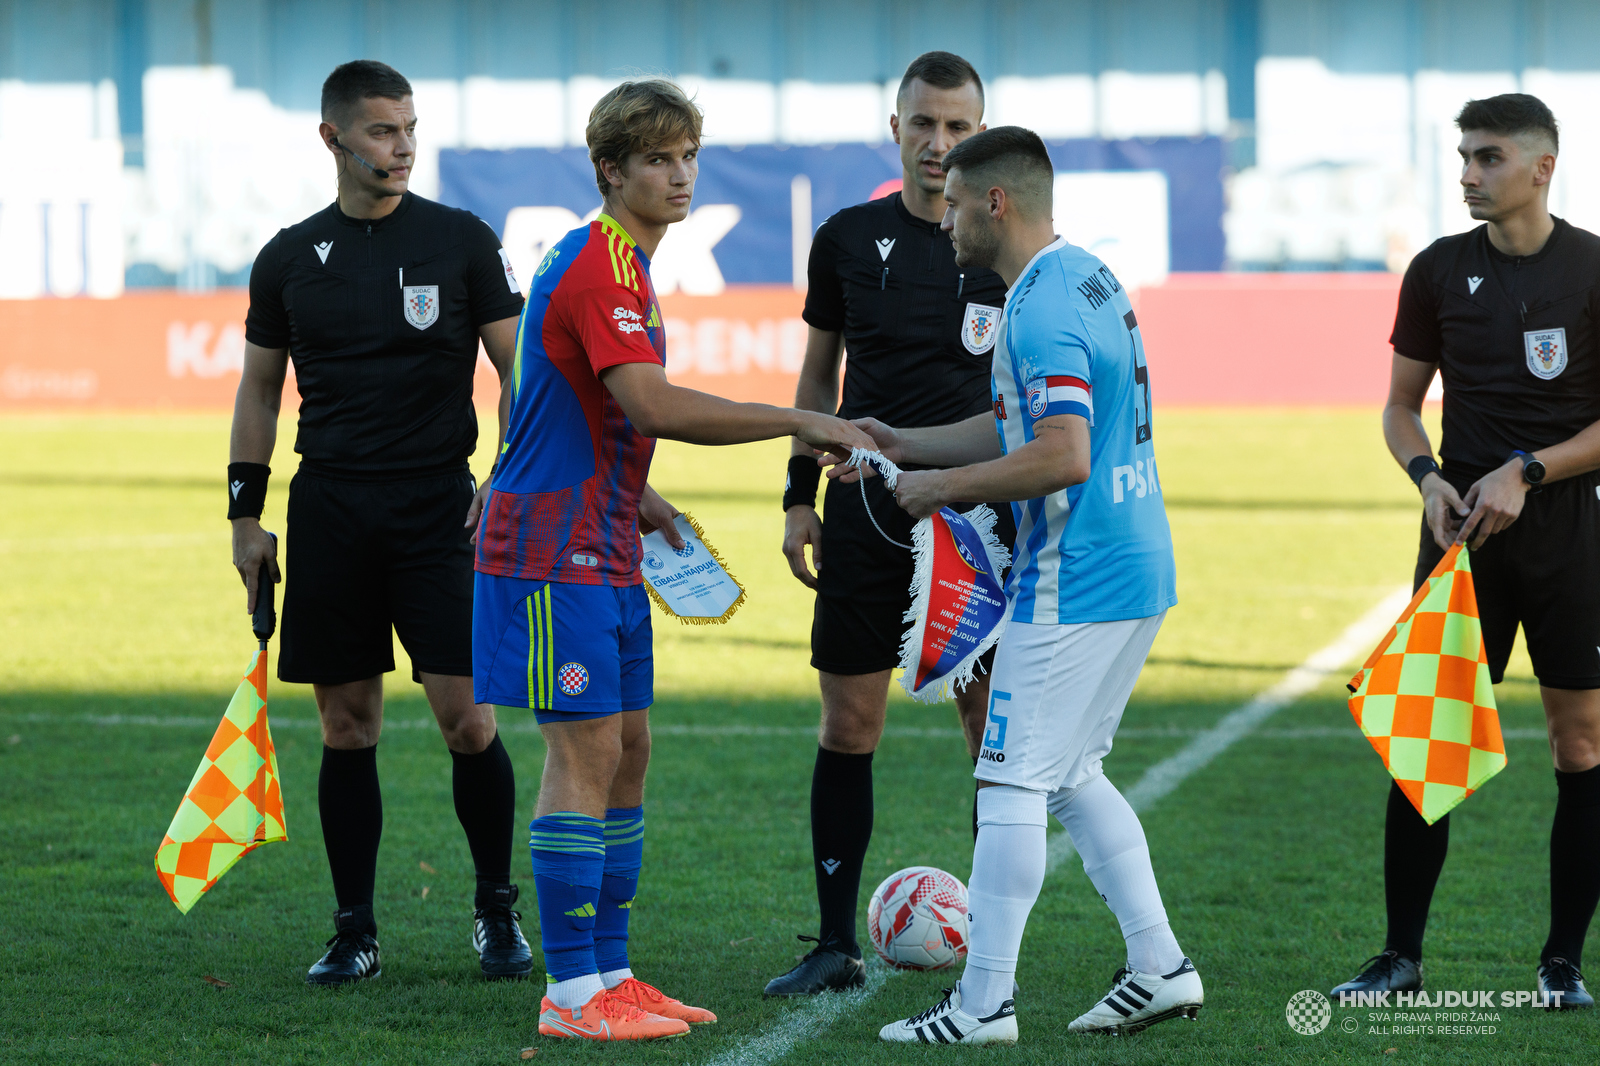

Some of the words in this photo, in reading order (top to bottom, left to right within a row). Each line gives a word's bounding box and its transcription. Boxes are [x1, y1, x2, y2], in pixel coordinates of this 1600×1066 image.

[1077, 273, 1112, 311] HNK
[707, 566, 720, 575] SPLIT
[938, 579, 963, 592] HRVATSKI
[963, 587, 992, 603] NOGOMETNI
[991, 599, 1001, 607] KUP
[957, 579, 988, 594] SUPERSPORT
[958, 594, 979, 606] 2025/26
[960, 605, 978, 616] FINALA
[940, 609, 955, 620] HNK
[955, 615, 980, 629] CIBALIA
[930, 620, 947, 632] HNK
[947, 627, 978, 644] HAJDUK
[937, 637, 960, 650] Vinkovci
[560, 664, 585, 674] HAJDUK
[562, 686, 582, 694] SPLIT
[984, 689, 1011, 750] 5
[980, 748, 1006, 763] JAKO
